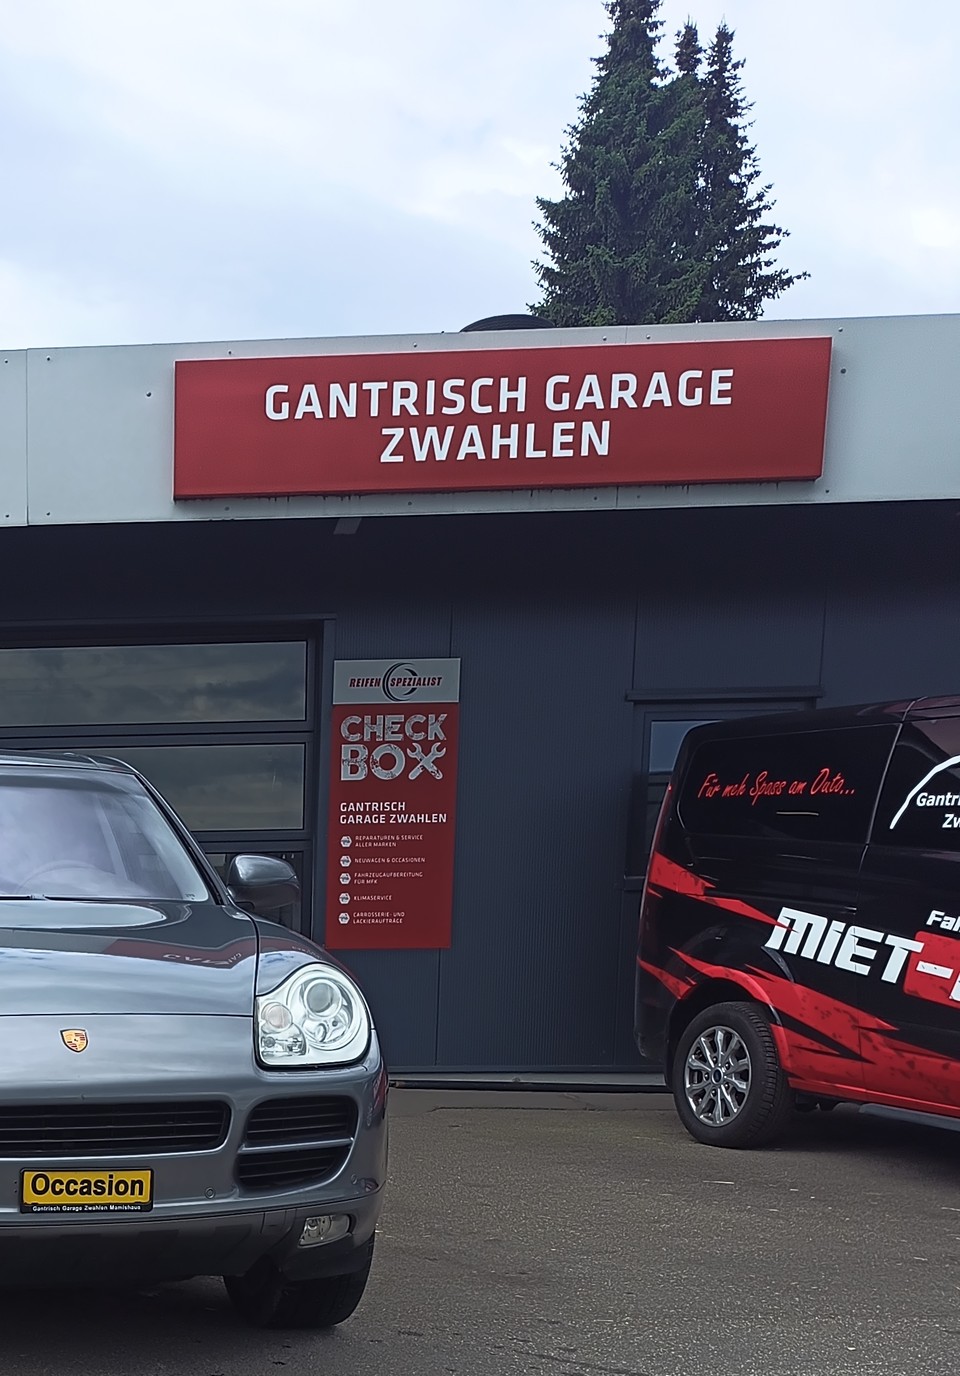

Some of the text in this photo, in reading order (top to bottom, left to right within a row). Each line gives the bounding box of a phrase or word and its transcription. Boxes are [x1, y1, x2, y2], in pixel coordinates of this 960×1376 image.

[264, 368, 735, 421] GANTRISCH GARAGE
[380, 420, 611, 463] ZWAHLEN
[349, 677, 442, 687] REIFEN SPEZIALIST
[340, 714, 447, 742] CHECK
[341, 742, 446, 780] BOX
[698, 773, 721, 798] Für
[722, 773, 750, 797] meh
[750, 771, 787, 806] Spass
[788, 781, 807, 794] am
[340, 802, 405, 812] GANTRISCH
[340, 813, 447, 824] GARAGE ZWAHLEN
[765, 907, 960, 1001] MIET-
[31, 1173, 144, 1196] Occasion
